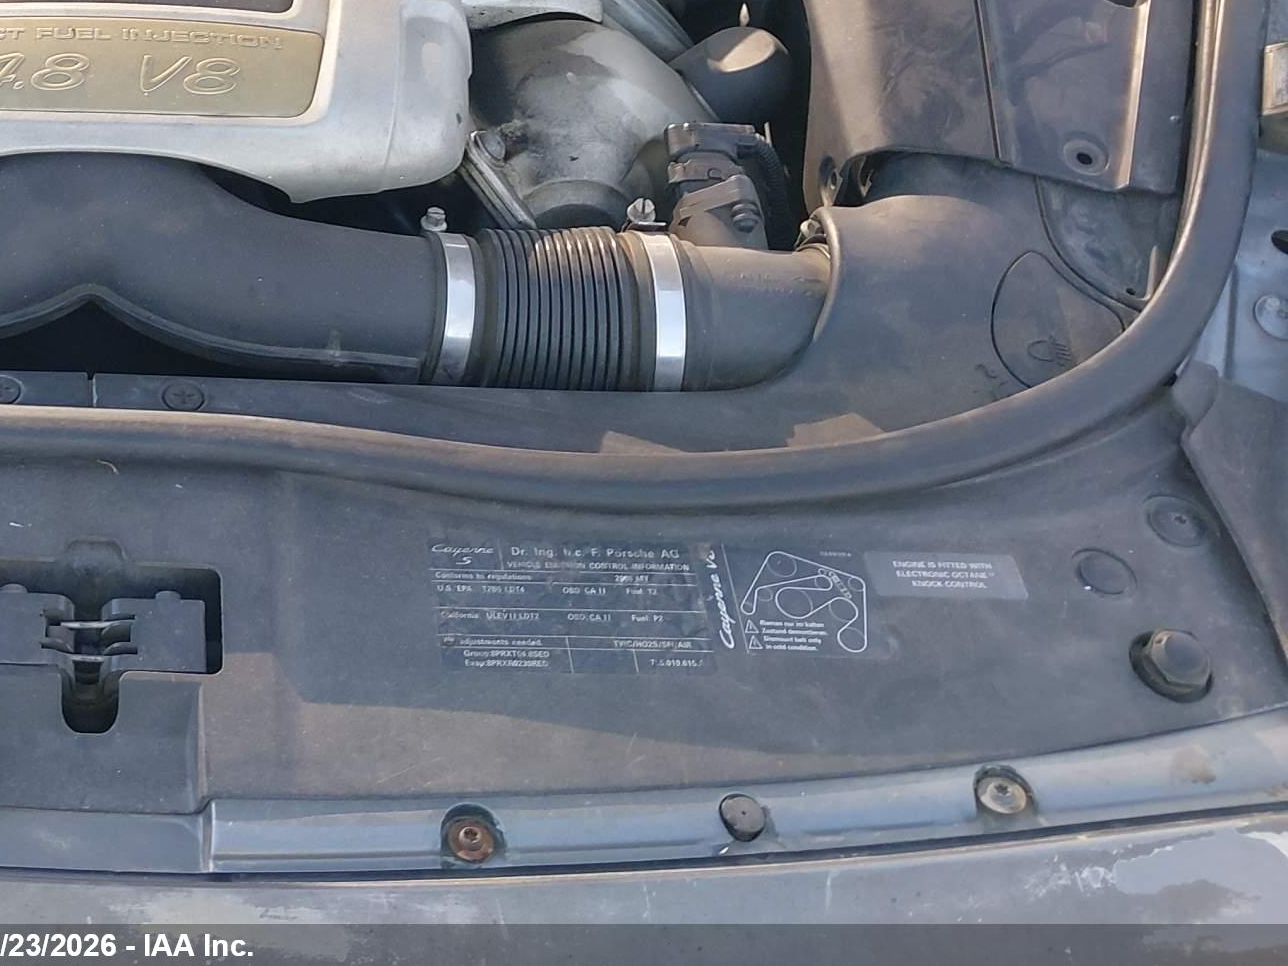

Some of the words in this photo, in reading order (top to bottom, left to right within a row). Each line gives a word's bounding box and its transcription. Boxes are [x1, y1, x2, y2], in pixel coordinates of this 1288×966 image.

[35, 26, 112, 41] FUEL
[122, 27, 283, 51] INJECTION
[138, 54, 241, 96] V8
[431, 543, 494, 557] Cayenne
[511, 546, 529, 557] Dr.
[534, 546, 557, 558] Ing.
[591, 548, 601, 558] F.
[606, 548, 655, 559] Porsche
[660, 548, 680, 560] AG
[455, 555, 473, 565] S
[892, 560, 926, 569] ENGINE
[927, 561, 937, 569] IS
[938, 561, 967, 570] FITTED
[968, 561, 993, 570] WITH
[588, 562, 628, 571] CONTROL
[629, 563, 690, 572] INFORMATION
[895, 570, 950, 579] ELECTRONIC
[911, 579, 944, 588] KNOCK
[945, 580, 989, 589] CONTROL
[710, 572, 737, 650] Cayenne
